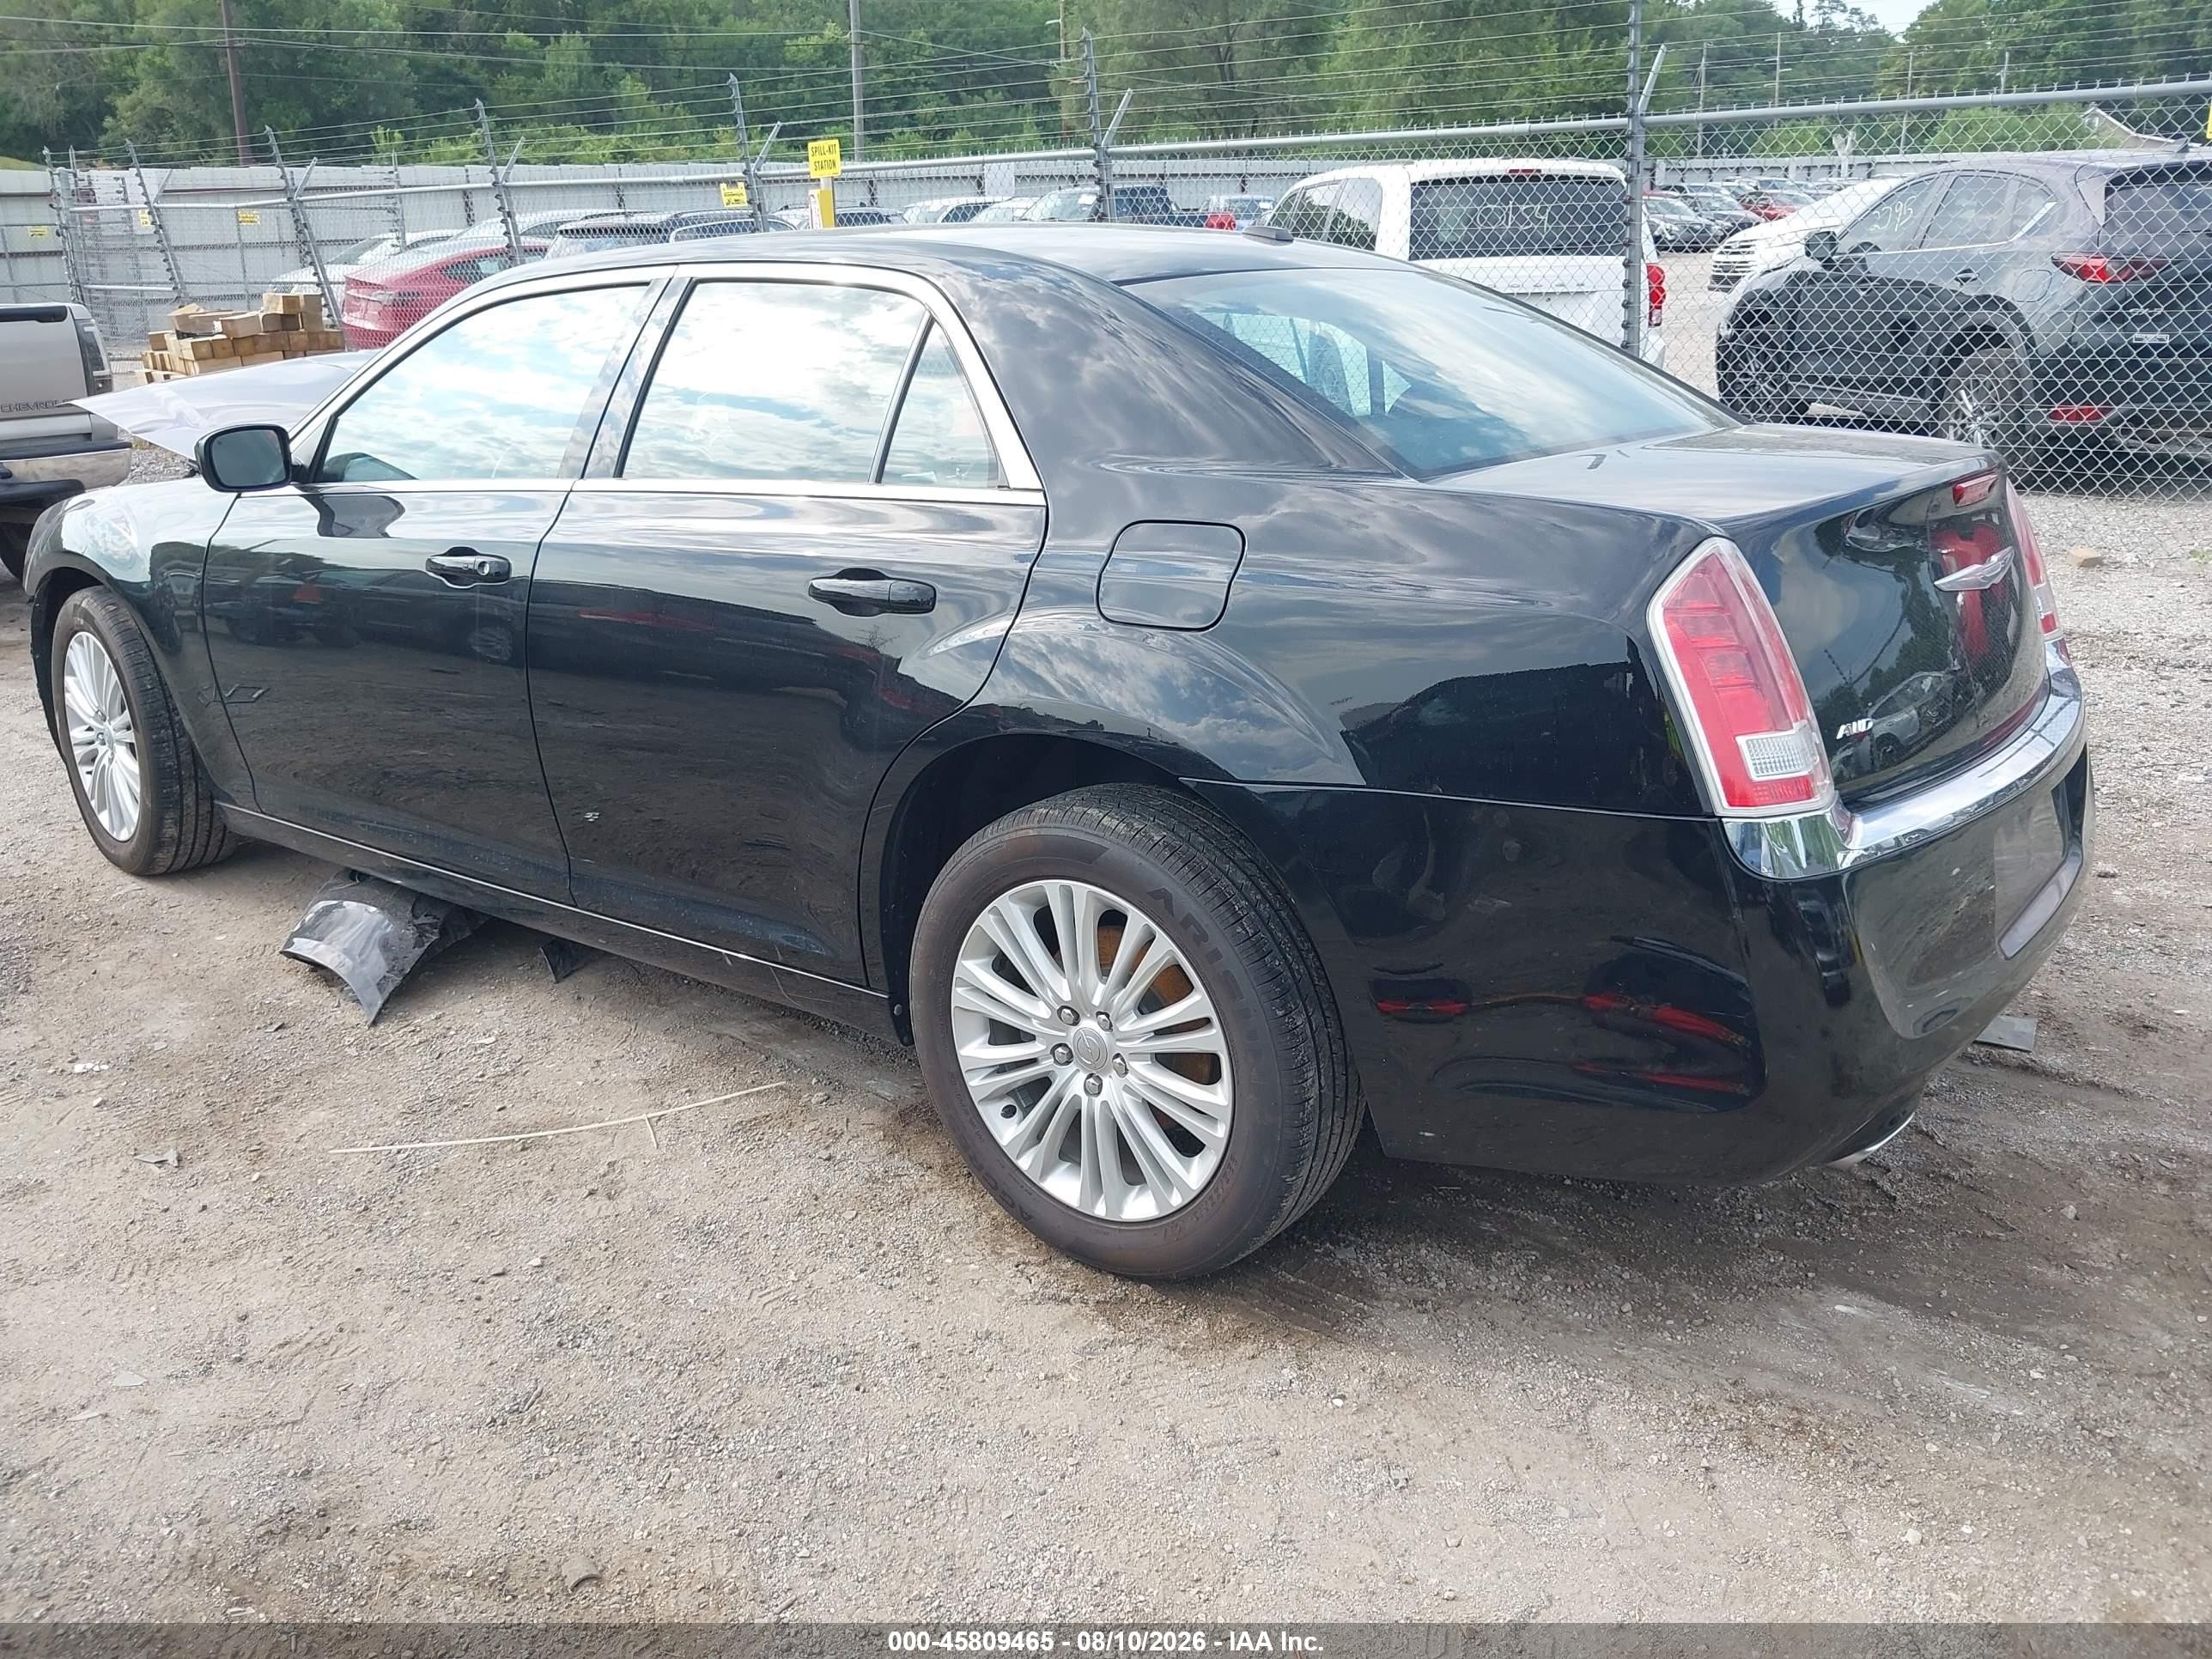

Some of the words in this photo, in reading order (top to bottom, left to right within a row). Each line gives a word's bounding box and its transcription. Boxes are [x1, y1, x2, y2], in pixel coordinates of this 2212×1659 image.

[811, 144, 836, 157] SPILL-KIT
[813, 159, 836, 172] STATION
[1836, 718, 1874, 739] AWD
